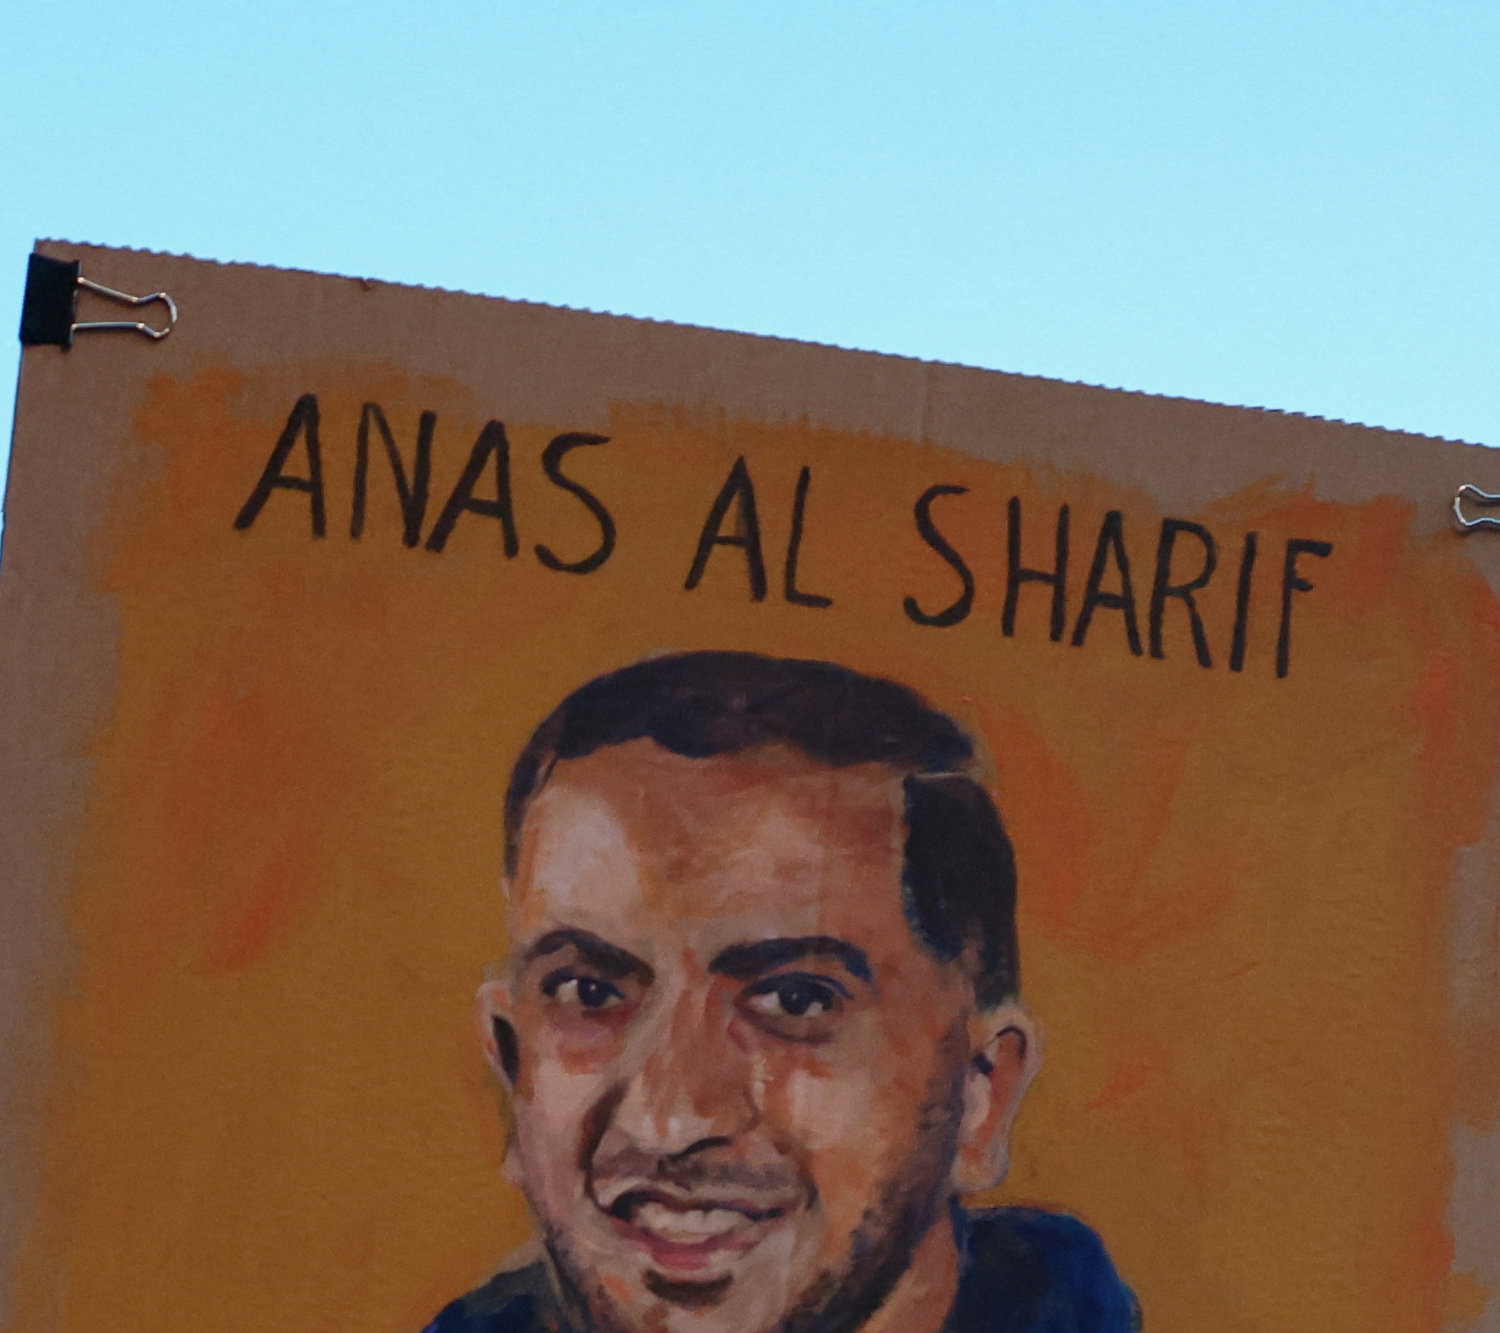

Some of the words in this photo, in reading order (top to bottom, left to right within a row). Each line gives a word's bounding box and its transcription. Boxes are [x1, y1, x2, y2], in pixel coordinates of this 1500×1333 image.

[232, 392, 616, 575] ANAS
[683, 454, 834, 608] AL
[902, 482, 1335, 679] SHARIF
